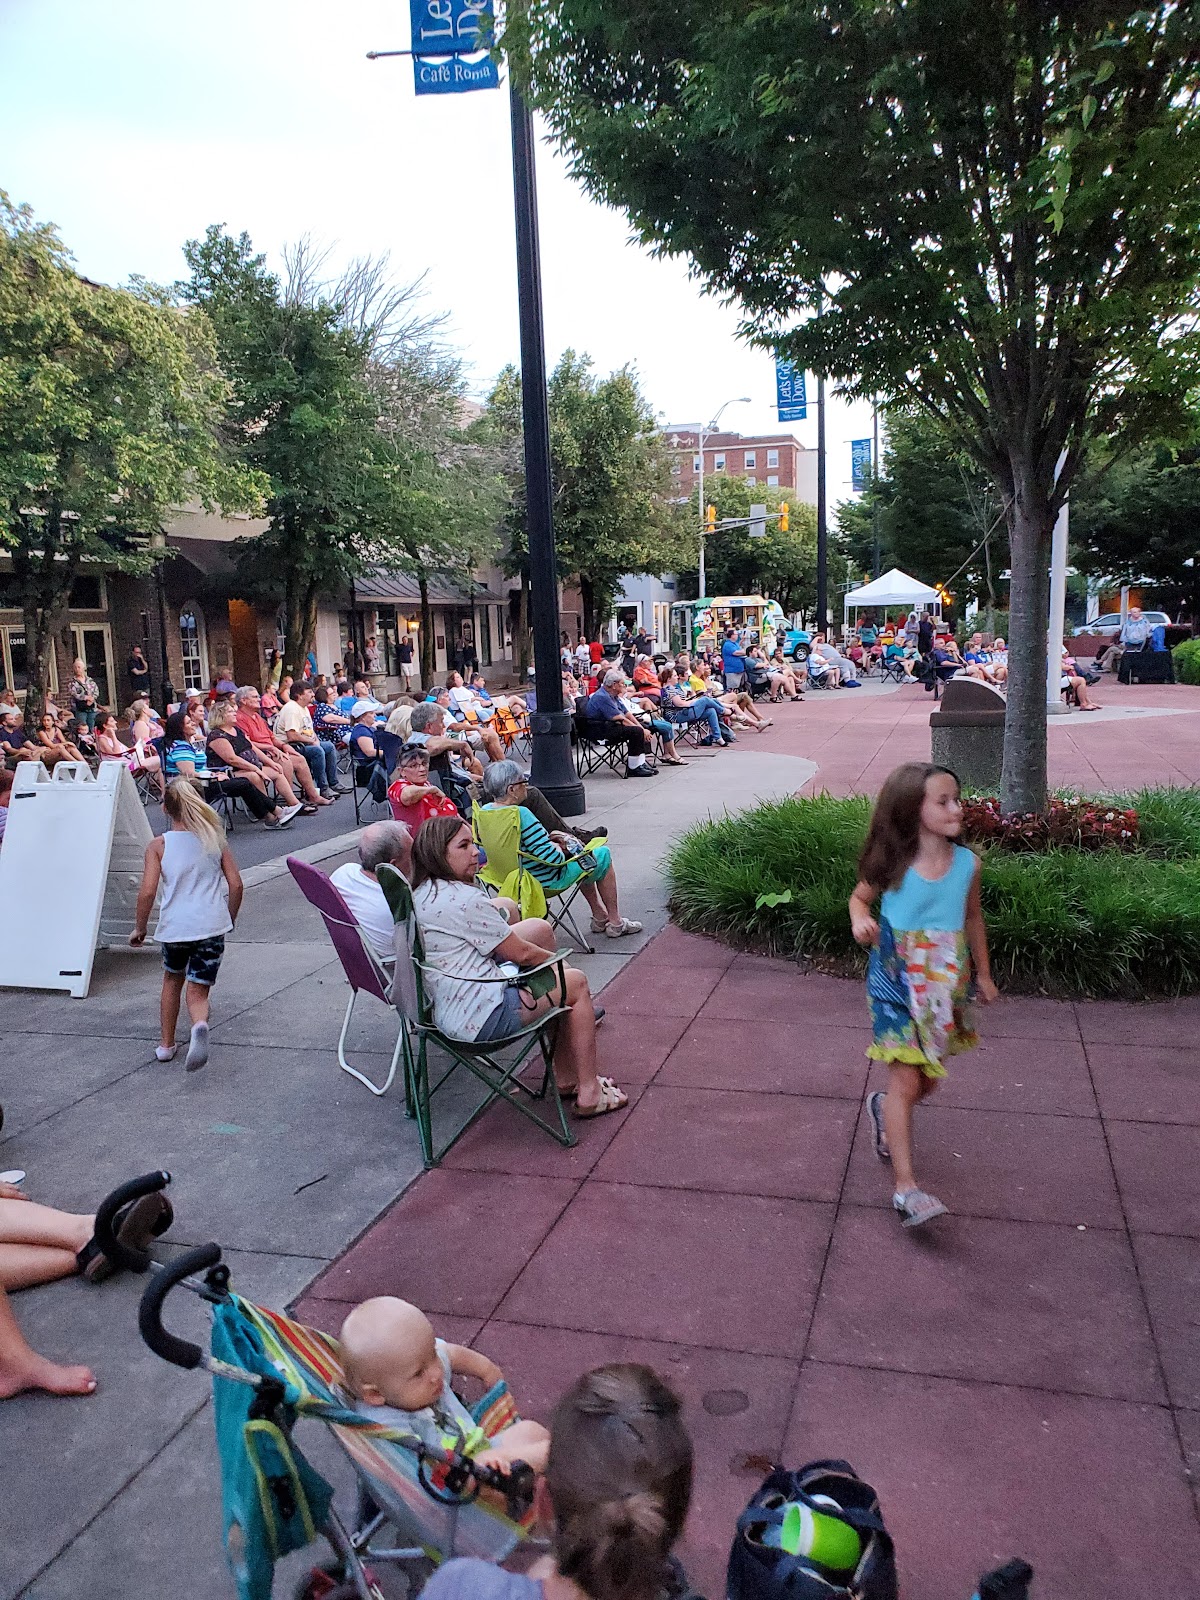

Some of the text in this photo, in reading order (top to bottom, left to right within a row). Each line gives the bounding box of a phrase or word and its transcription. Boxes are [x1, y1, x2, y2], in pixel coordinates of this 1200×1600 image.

[420, 64, 490, 83] Café Roma
[779, 380, 792, 404] Let's
